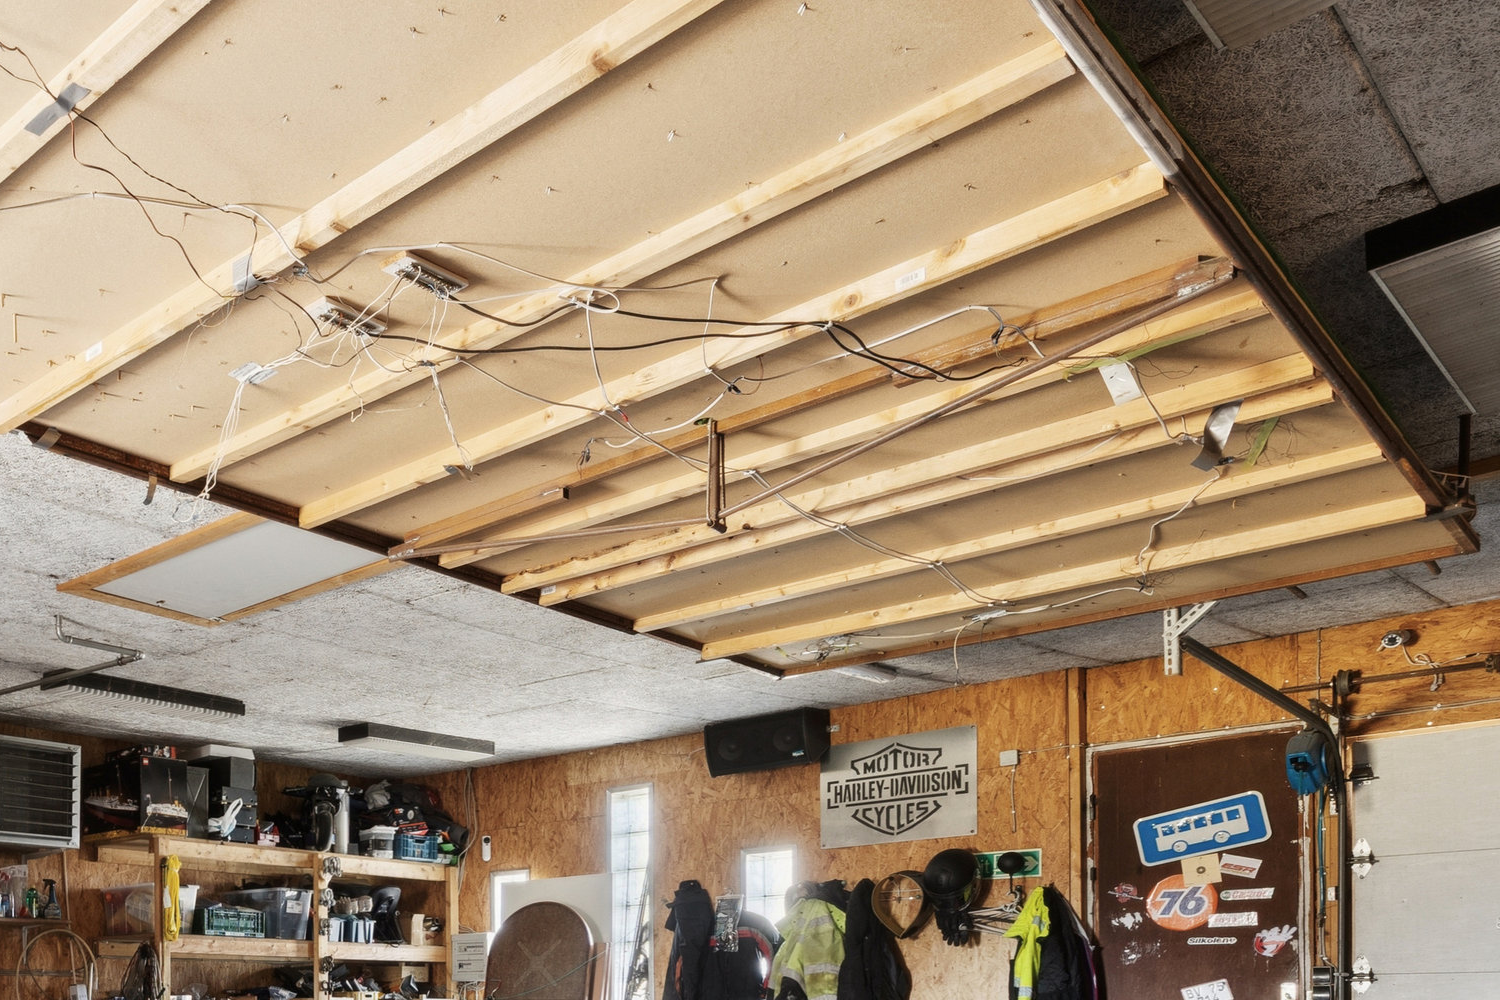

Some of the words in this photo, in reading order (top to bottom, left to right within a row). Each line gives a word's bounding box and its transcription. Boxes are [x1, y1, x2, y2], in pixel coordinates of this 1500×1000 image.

[863, 748, 929, 775] MOTOR
[833, 769, 963, 803] HARLEY-DAVIDSON
[862, 801, 929, 830] CYCLES
[1222, 862, 1256, 873] ESR
[1159, 886, 1207, 918] 76
[1186, 987, 1200, 999] BV
